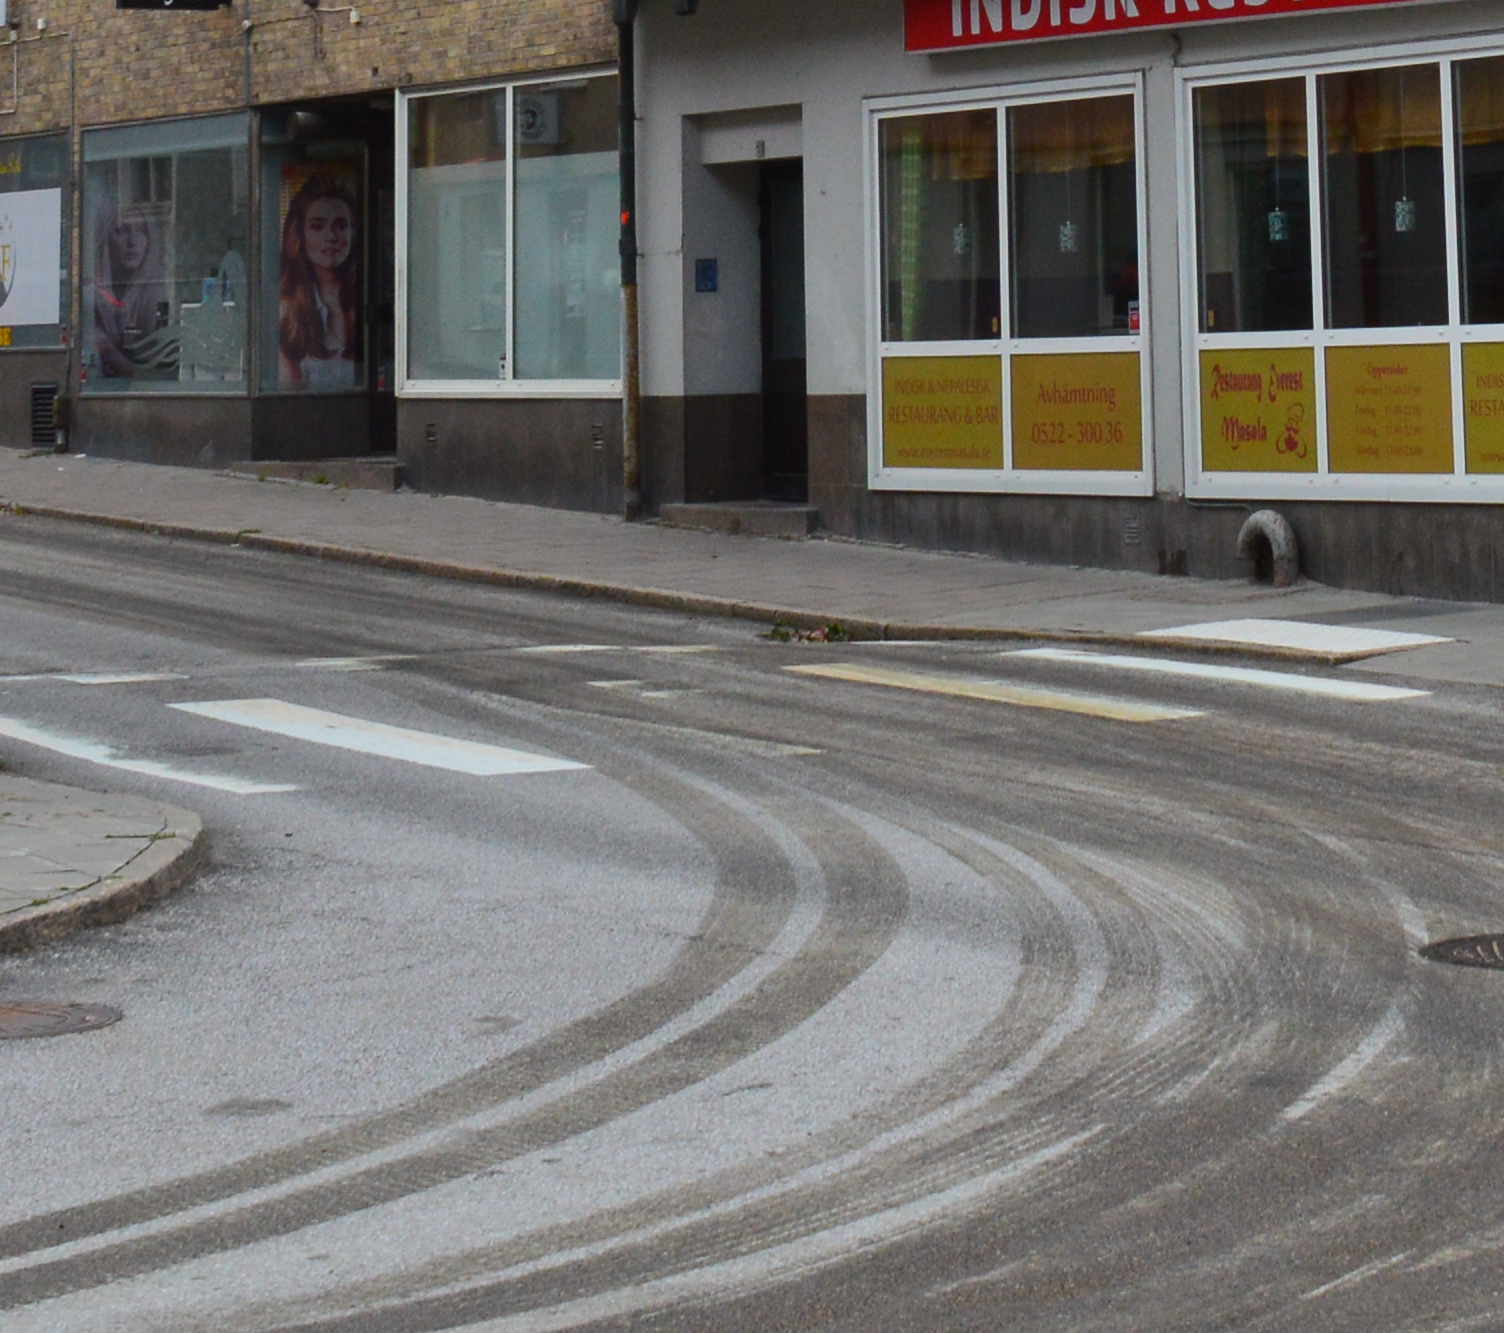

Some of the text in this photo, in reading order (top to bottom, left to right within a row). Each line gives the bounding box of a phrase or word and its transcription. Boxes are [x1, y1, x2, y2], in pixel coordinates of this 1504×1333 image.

[1037, 383, 1117, 412] Avhämtning
[888, 406, 962, 424] RESTAURANG
[976, 406, 999, 424] BAR
[1031, 422, 1065, 445] 0522
[1105, 421, 1123, 443] 36
